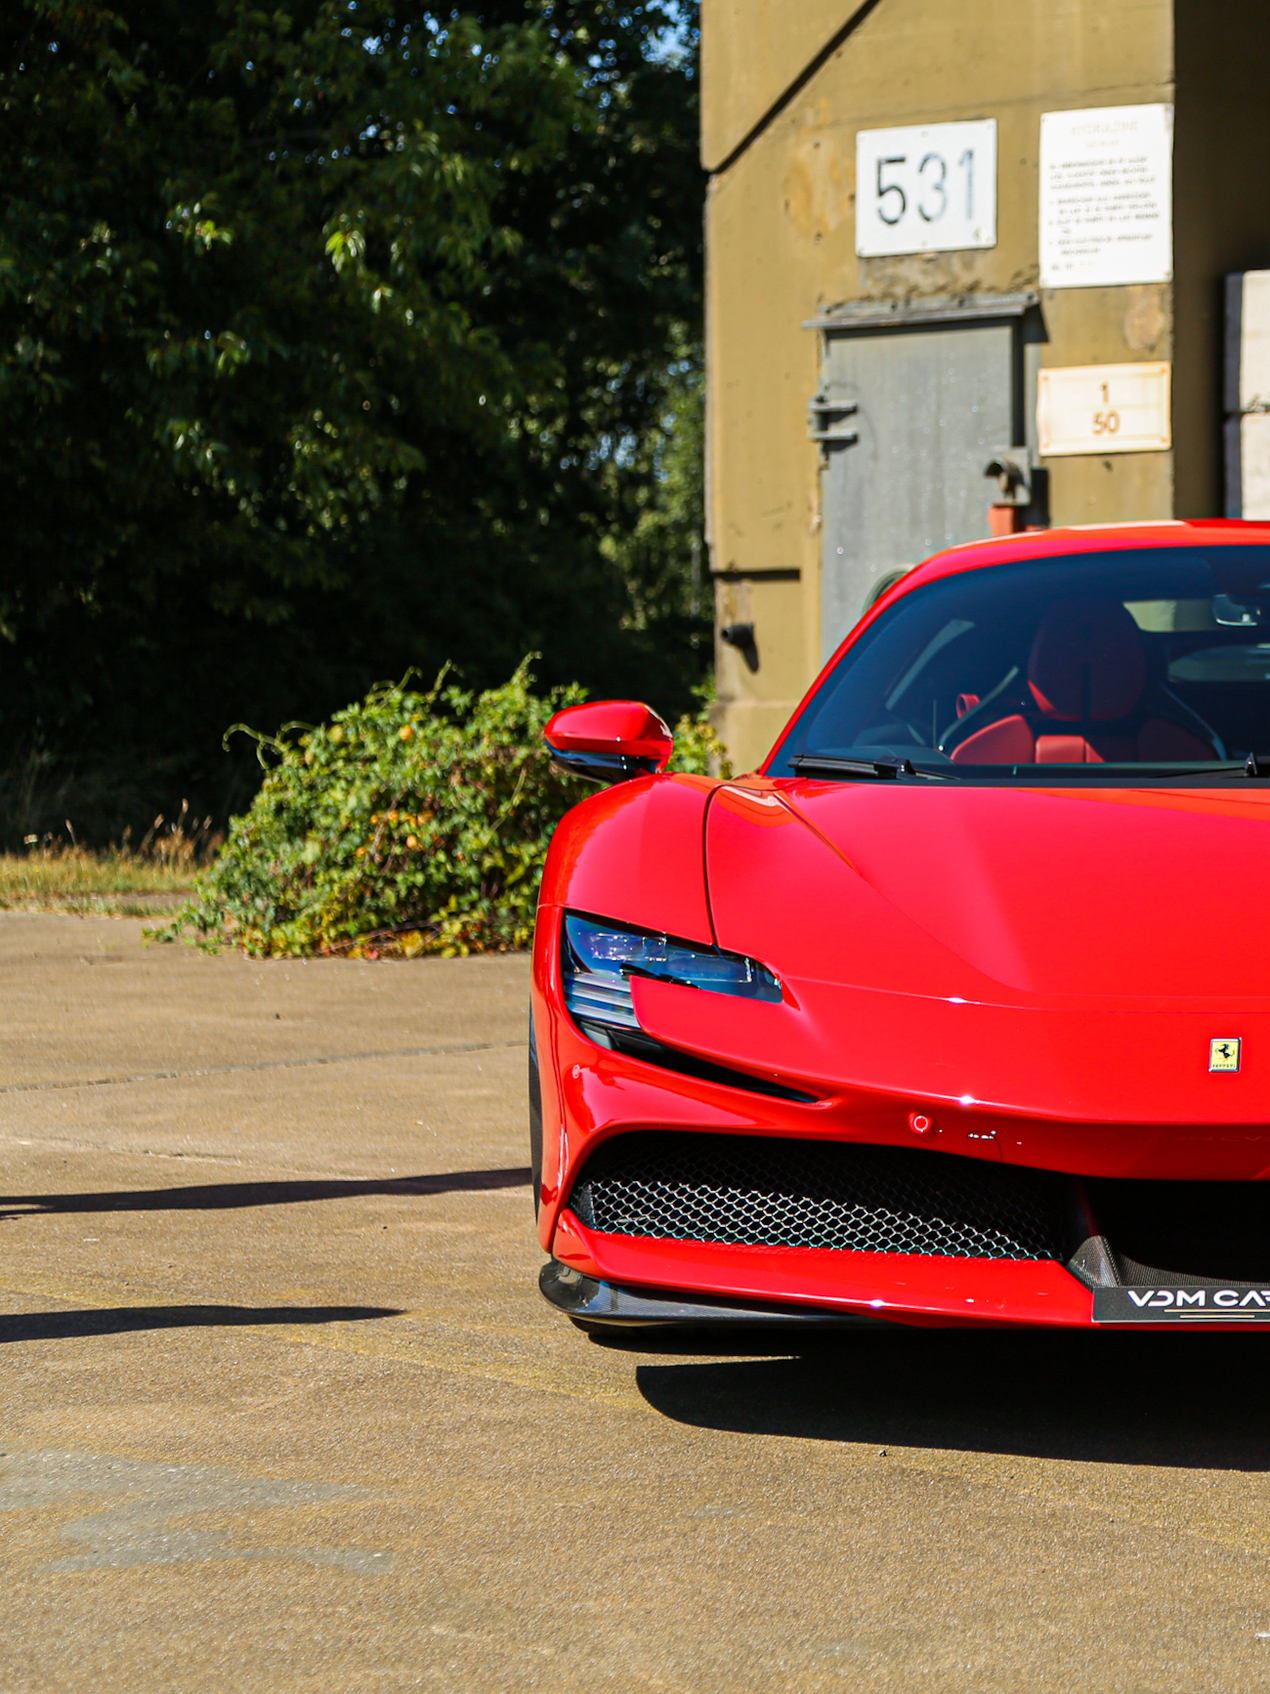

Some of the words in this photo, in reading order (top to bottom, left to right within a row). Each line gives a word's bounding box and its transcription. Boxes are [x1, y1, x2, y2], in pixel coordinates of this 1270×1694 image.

[876, 148, 974, 225] 531
[1099, 381, 1109, 404] 1
[1093, 411, 1120, 435] 50
[1127, 1290, 1206, 1307] VDM
